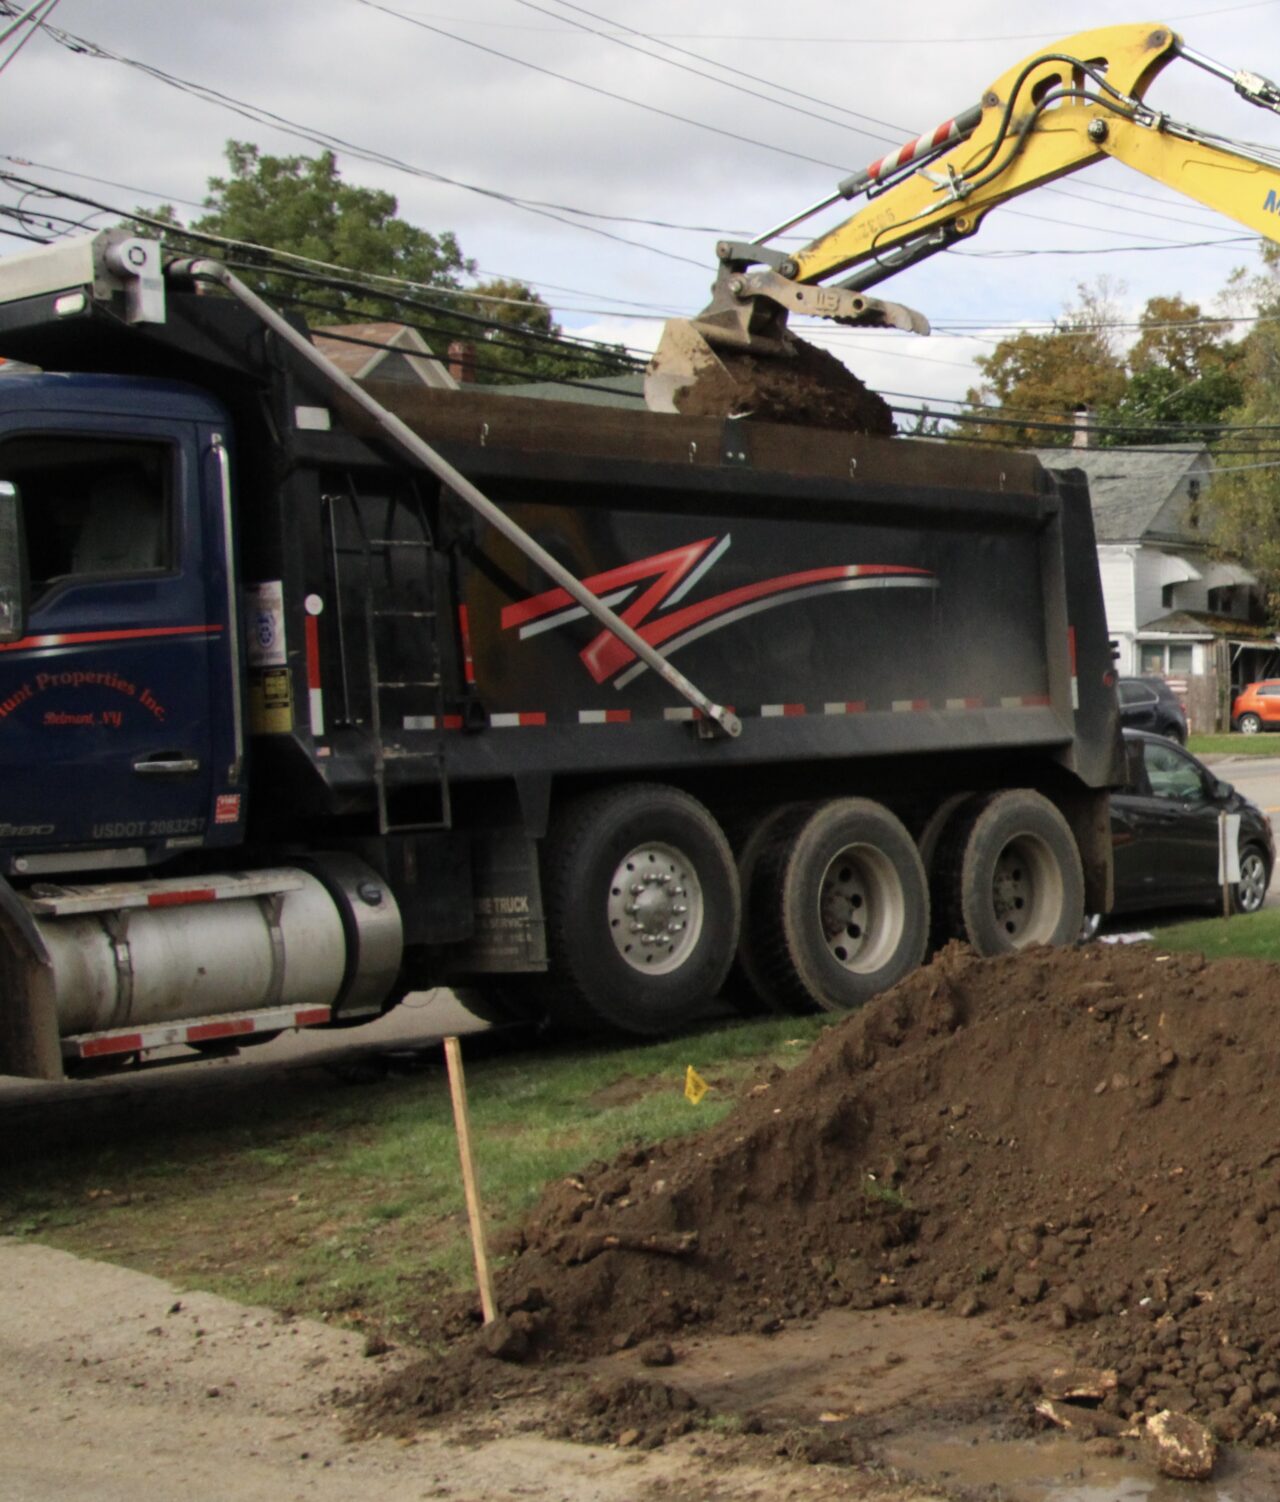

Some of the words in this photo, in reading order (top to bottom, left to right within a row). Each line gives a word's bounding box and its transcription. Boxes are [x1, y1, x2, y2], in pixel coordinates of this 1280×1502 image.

[36, 671, 135, 696] Properties
[138, 688, 166, 722] Inc.
[93, 823, 147, 839] USDOT
[493, 897, 529, 913] TRUCK
